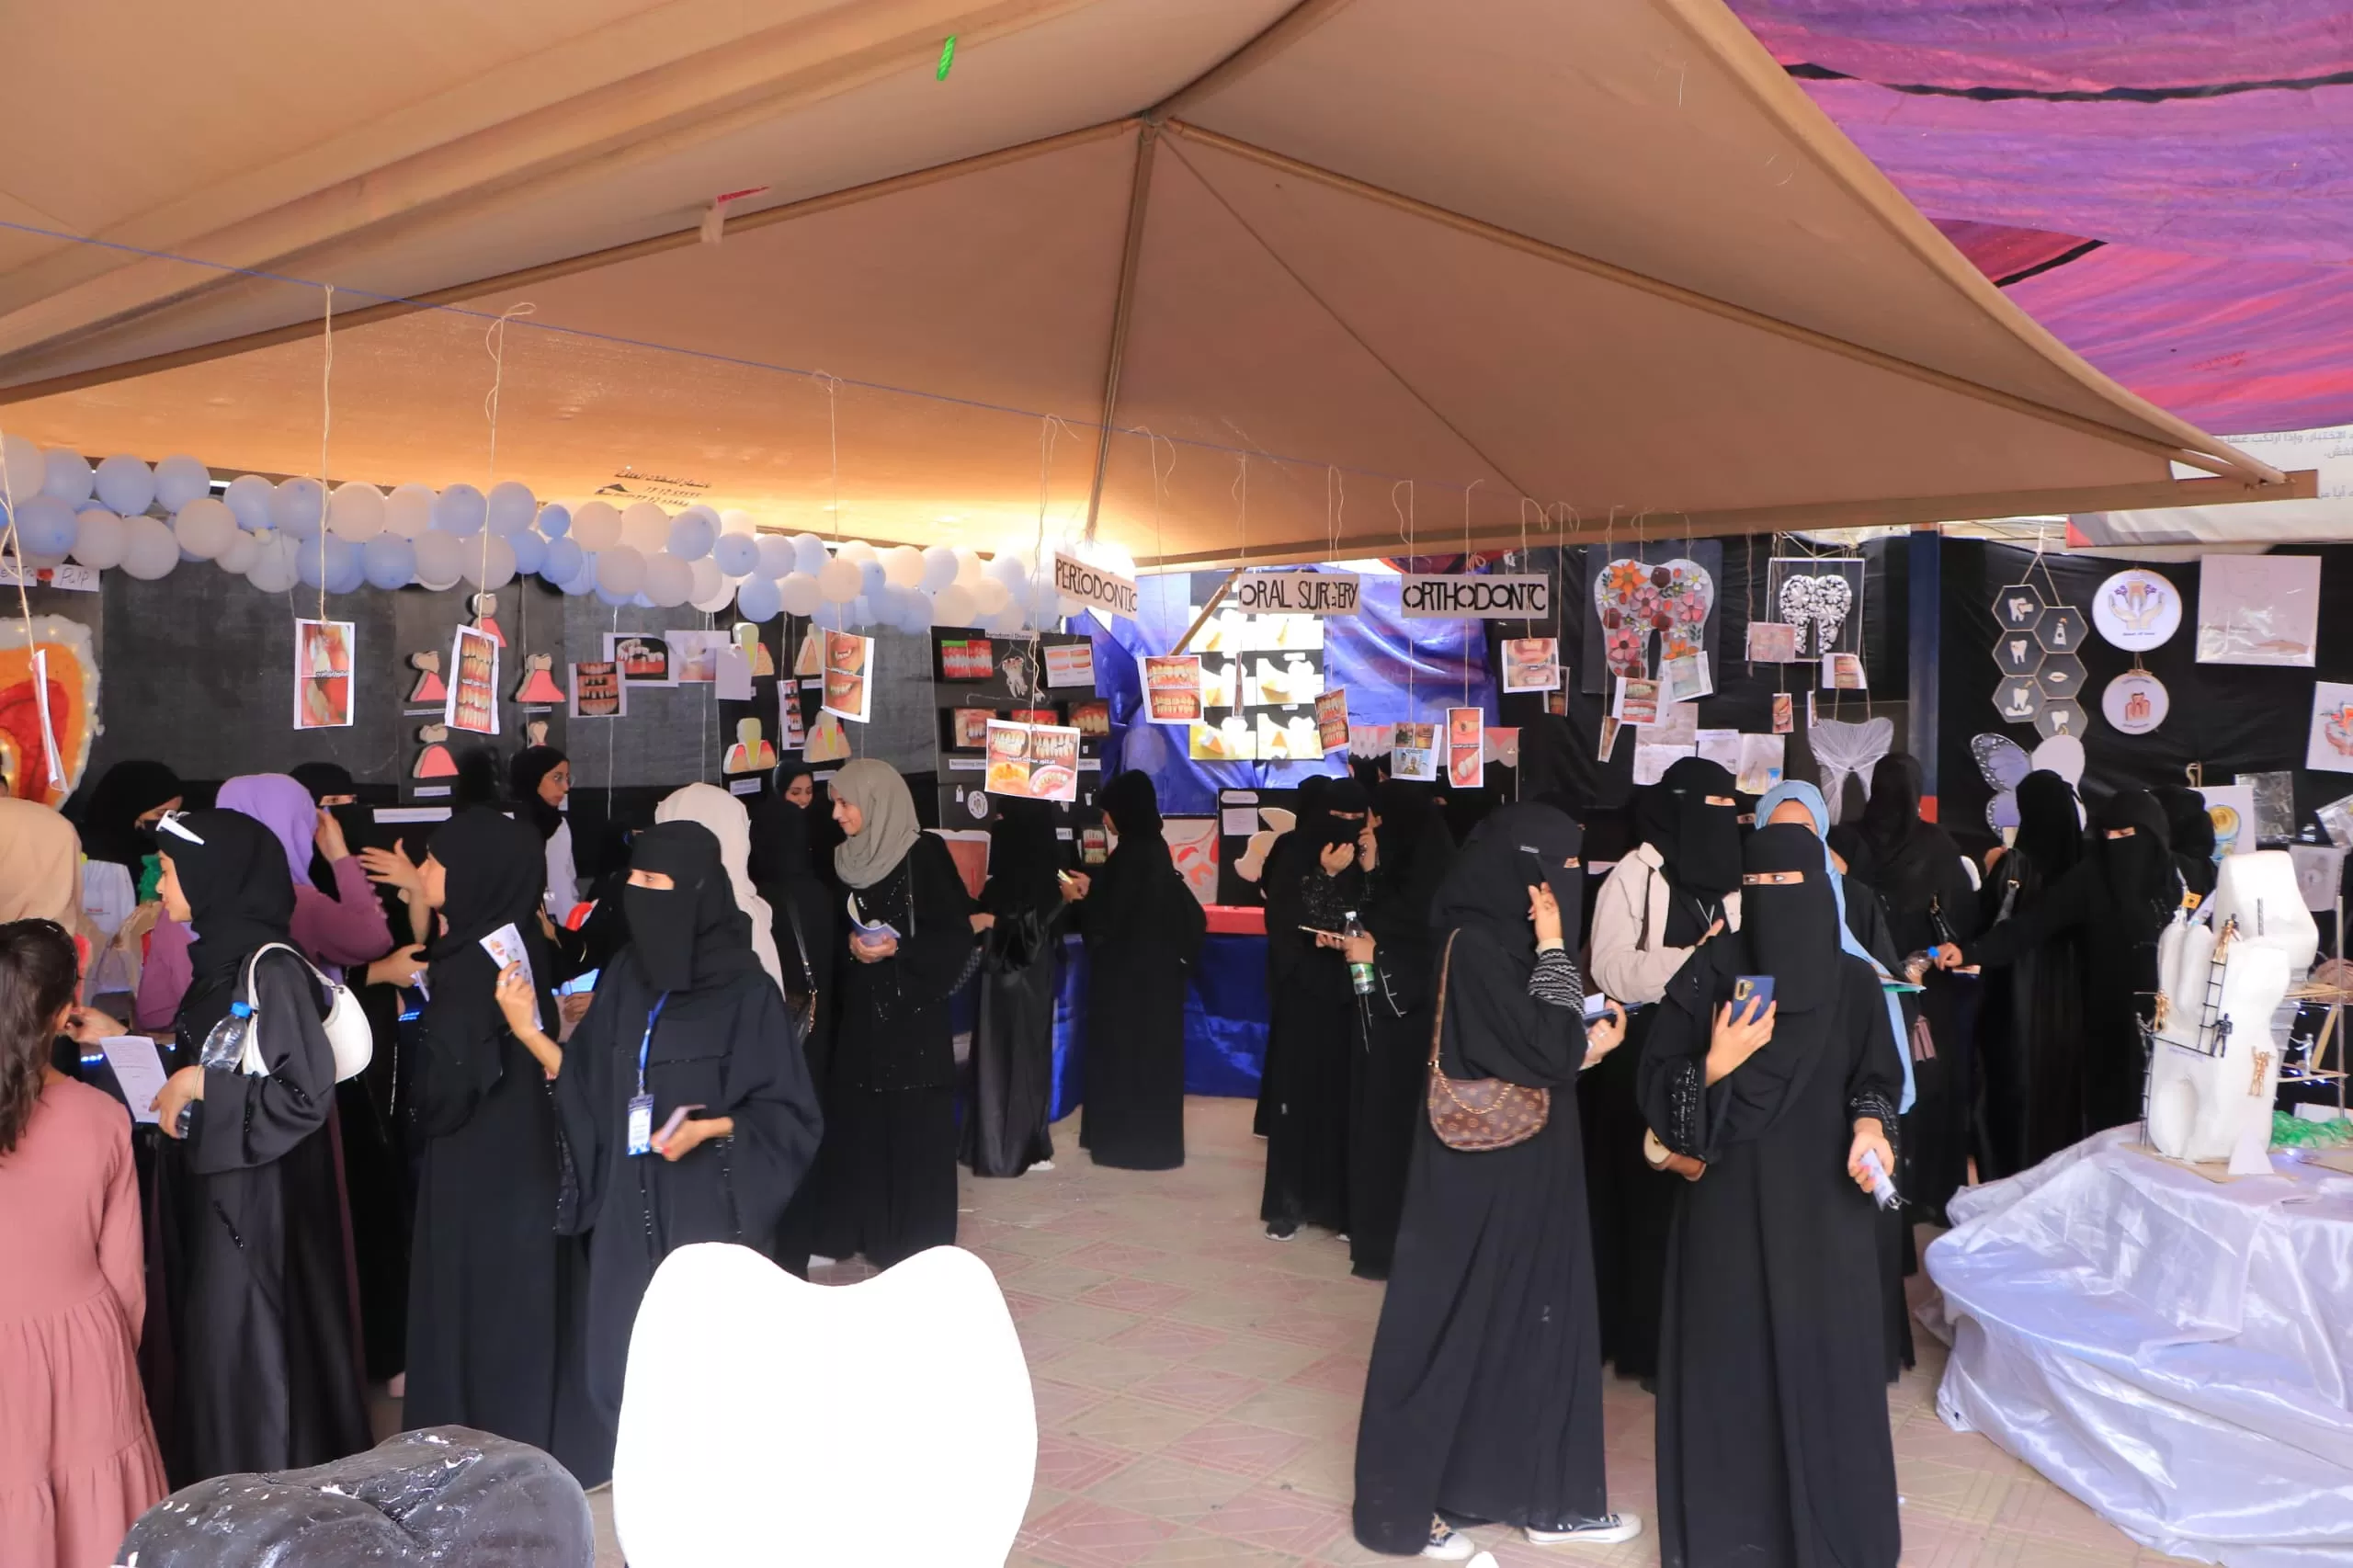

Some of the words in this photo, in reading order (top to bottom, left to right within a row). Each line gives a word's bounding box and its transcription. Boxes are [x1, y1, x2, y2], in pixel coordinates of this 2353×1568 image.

[1055, 558, 1138, 612] PERIODONTIC
[1239, 580, 1292, 608] ORAL
[1298, 580, 1358, 610] SURGERY
